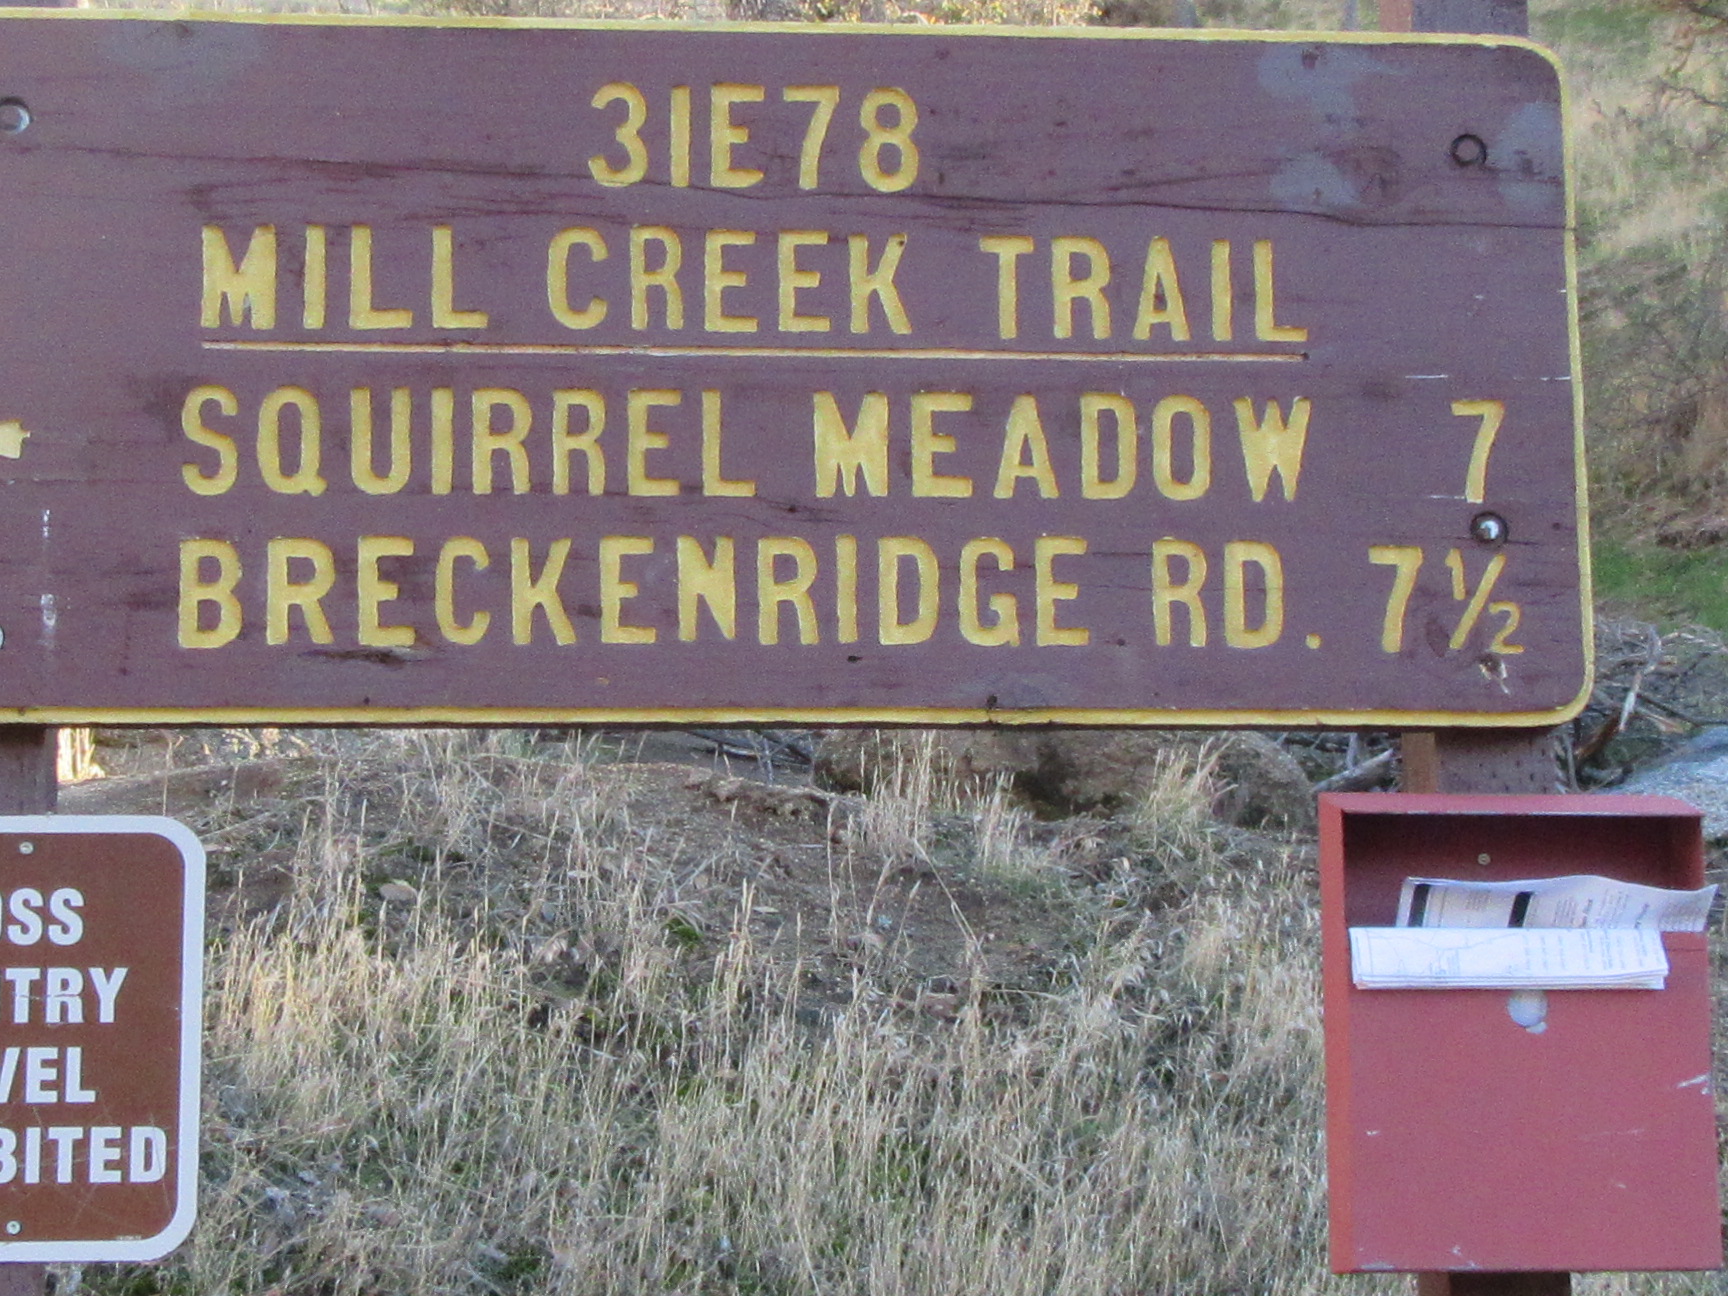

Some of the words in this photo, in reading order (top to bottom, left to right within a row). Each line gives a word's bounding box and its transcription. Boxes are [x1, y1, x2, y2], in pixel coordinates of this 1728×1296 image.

[588, 81, 922, 193] 31E78
[200, 223, 491, 331] MILL
[546, 224, 913, 335] CREEK
[979, 234, 1309, 343] TRAIL
[181, 383, 758, 499] SQUIRREL
[812, 389, 1313, 502] MEADOW
[1450, 398, 1506, 503] 7
[177, 533, 1091, 650] BRECKENRIDGE
[1151, 536, 1323, 649] RD.
